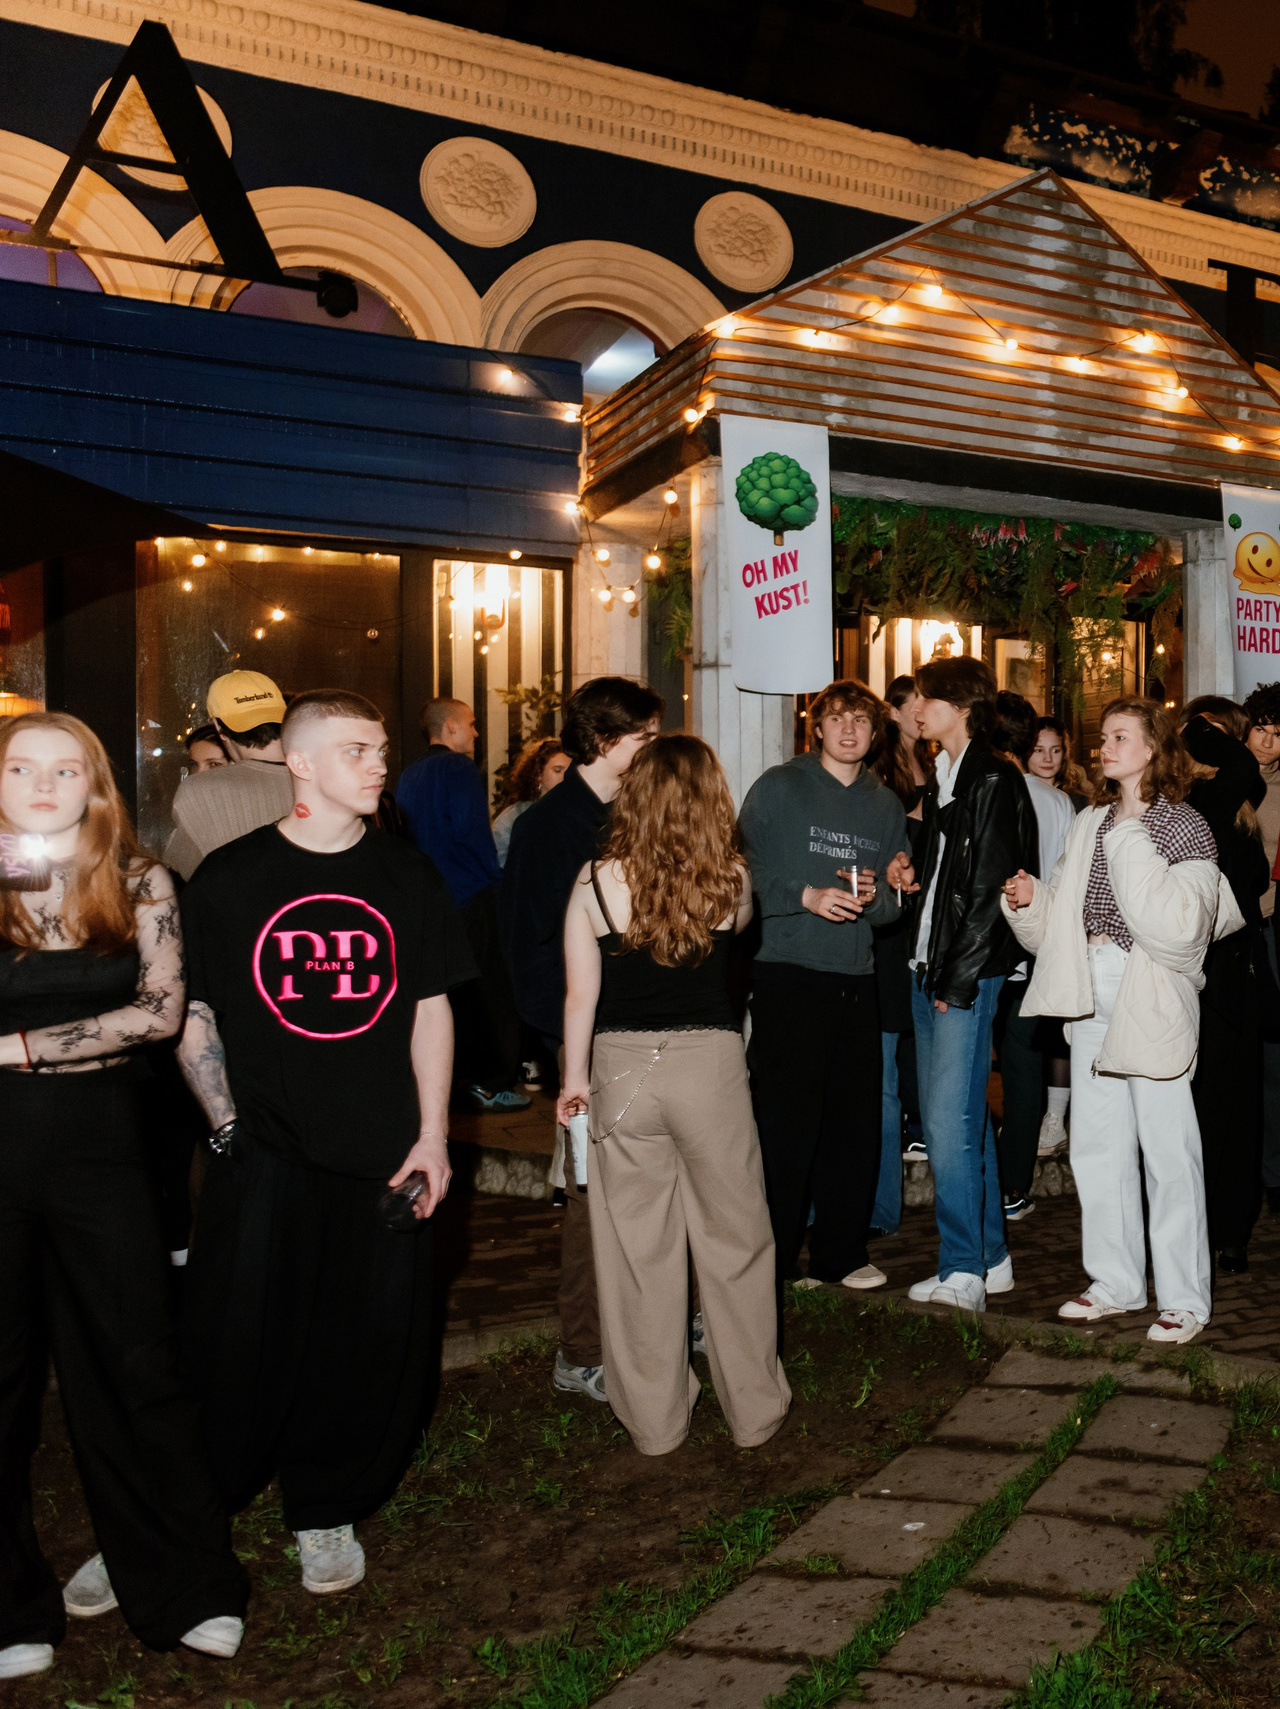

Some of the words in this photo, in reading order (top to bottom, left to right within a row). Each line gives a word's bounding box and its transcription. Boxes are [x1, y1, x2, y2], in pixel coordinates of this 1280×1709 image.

[742, 558, 769, 588] OH
[772, 550, 800, 579] MY
[754, 580, 810, 619] KUST!
[234, 692, 268, 704] Timberland
[810, 826, 851, 844] ENFANTS
[809, 839, 857, 860] DÉPRIMÉS
[305, 961, 341, 971] PLAN
[346, 961, 355, 971] B
